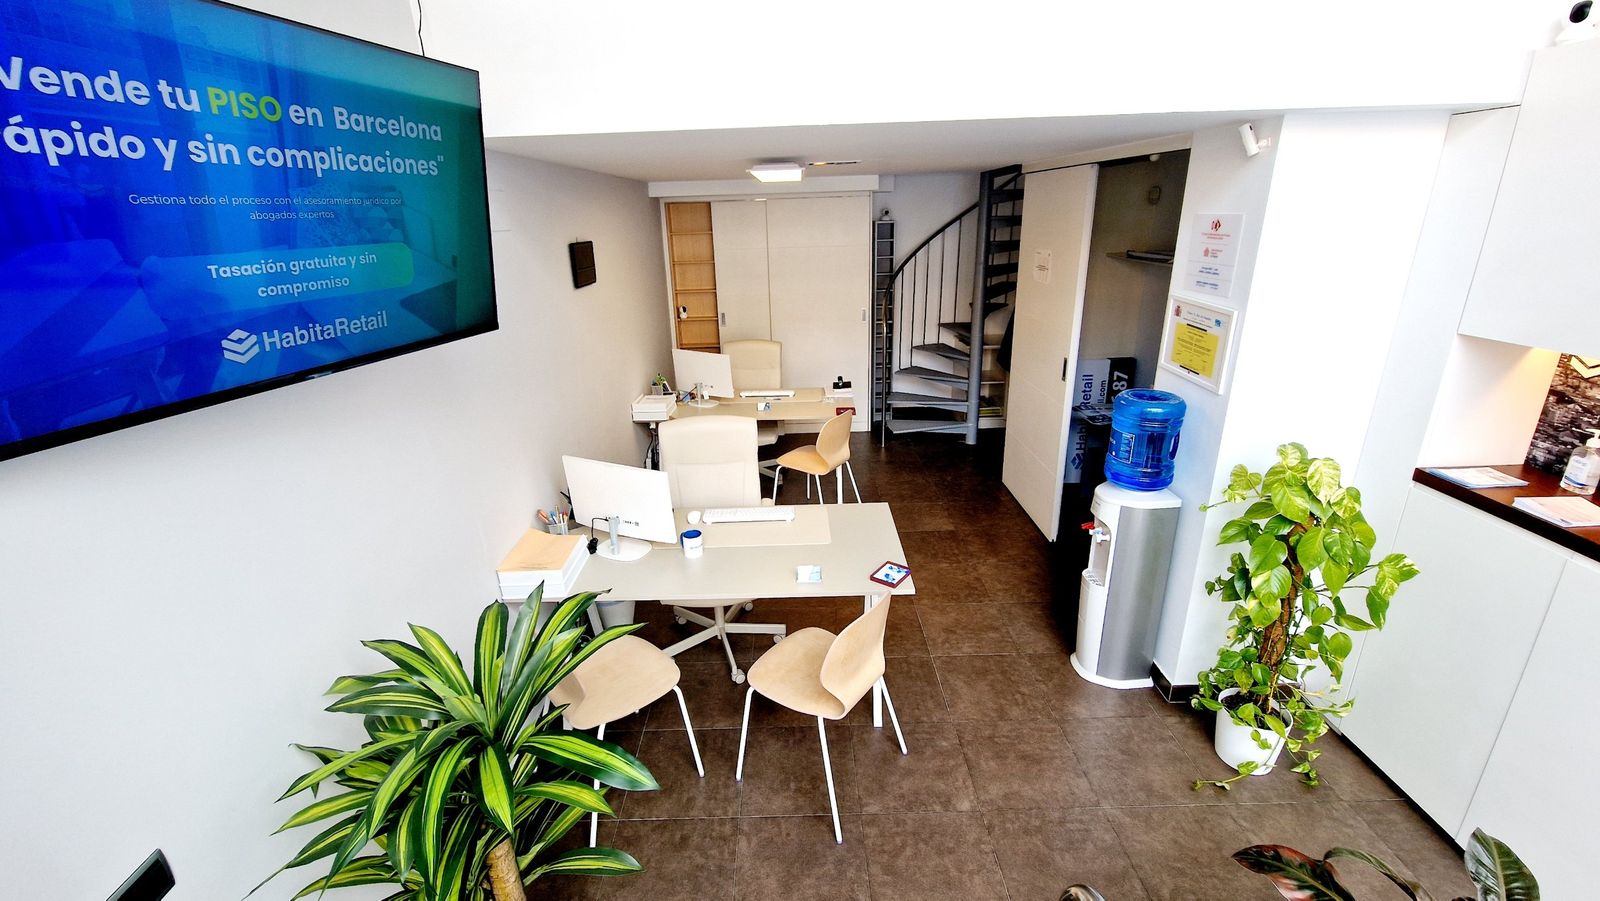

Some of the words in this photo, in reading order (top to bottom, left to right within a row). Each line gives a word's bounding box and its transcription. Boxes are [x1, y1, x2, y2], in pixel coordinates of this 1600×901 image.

[157, 79, 201, 112] tu
[207, 86, 282, 122] PISO
[288, 104, 324, 128] en
[333, 105, 442, 142] Barcelona
[0, 114, 146, 167] ápido
[152, 137, 177, 171] y
[187, 133, 241, 166] sin
[246, 145, 445, 178] complicaciones"
[128, 194, 186, 205] Gestiona
[188, 194, 217, 205] todo
[218, 195, 229, 205] el
[231, 197, 272, 207] proceso
[293, 196, 301, 205] el
[303, 196, 362, 206] asesoramiento
[250, 210, 297, 221] abogados
[298, 211, 335, 220] expertos
[207, 259, 286, 279] Tasación
[289, 254, 347, 275] gratuita
[349, 255, 357, 269] y
[359, 252, 377, 264] sin
[257, 276, 350, 297] compromiso
[262, 310, 388, 352] HabitaRetail
